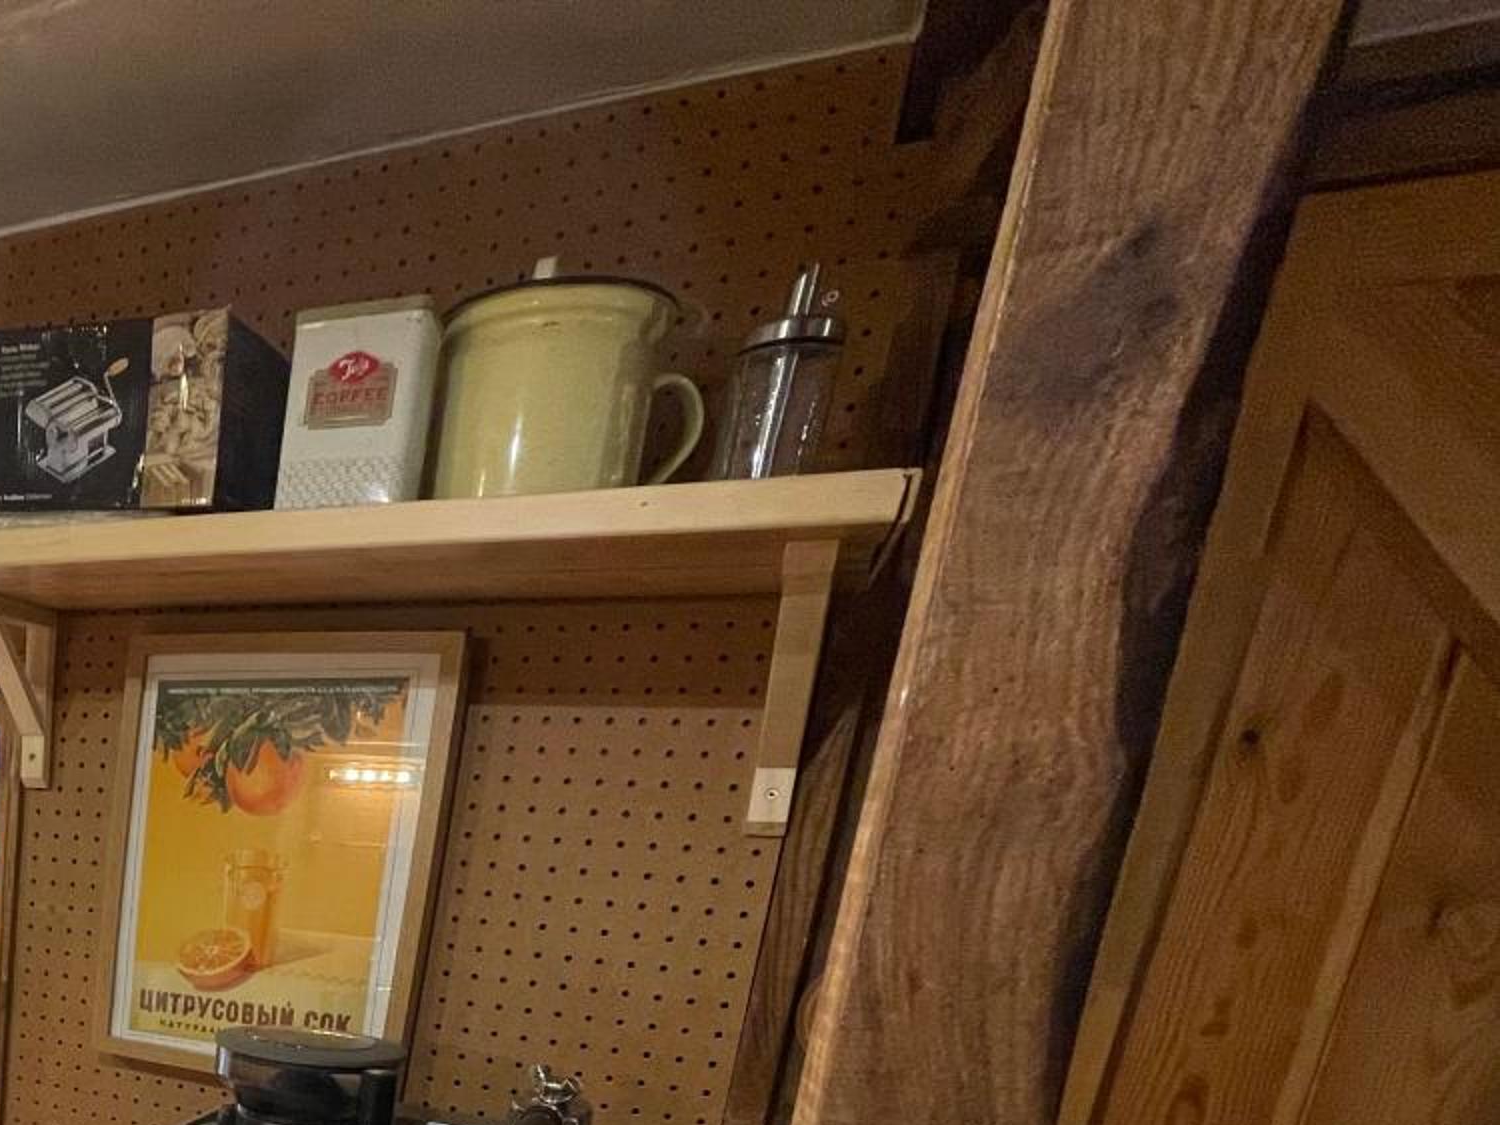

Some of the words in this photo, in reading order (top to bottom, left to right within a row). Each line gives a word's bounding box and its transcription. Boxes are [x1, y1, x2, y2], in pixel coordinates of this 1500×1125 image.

[311, 386, 390, 406] COFFEE
[138, 988, 295, 1027] ЦИТРУСОВЫЙ
[303, 1010, 352, 1031] СОК
